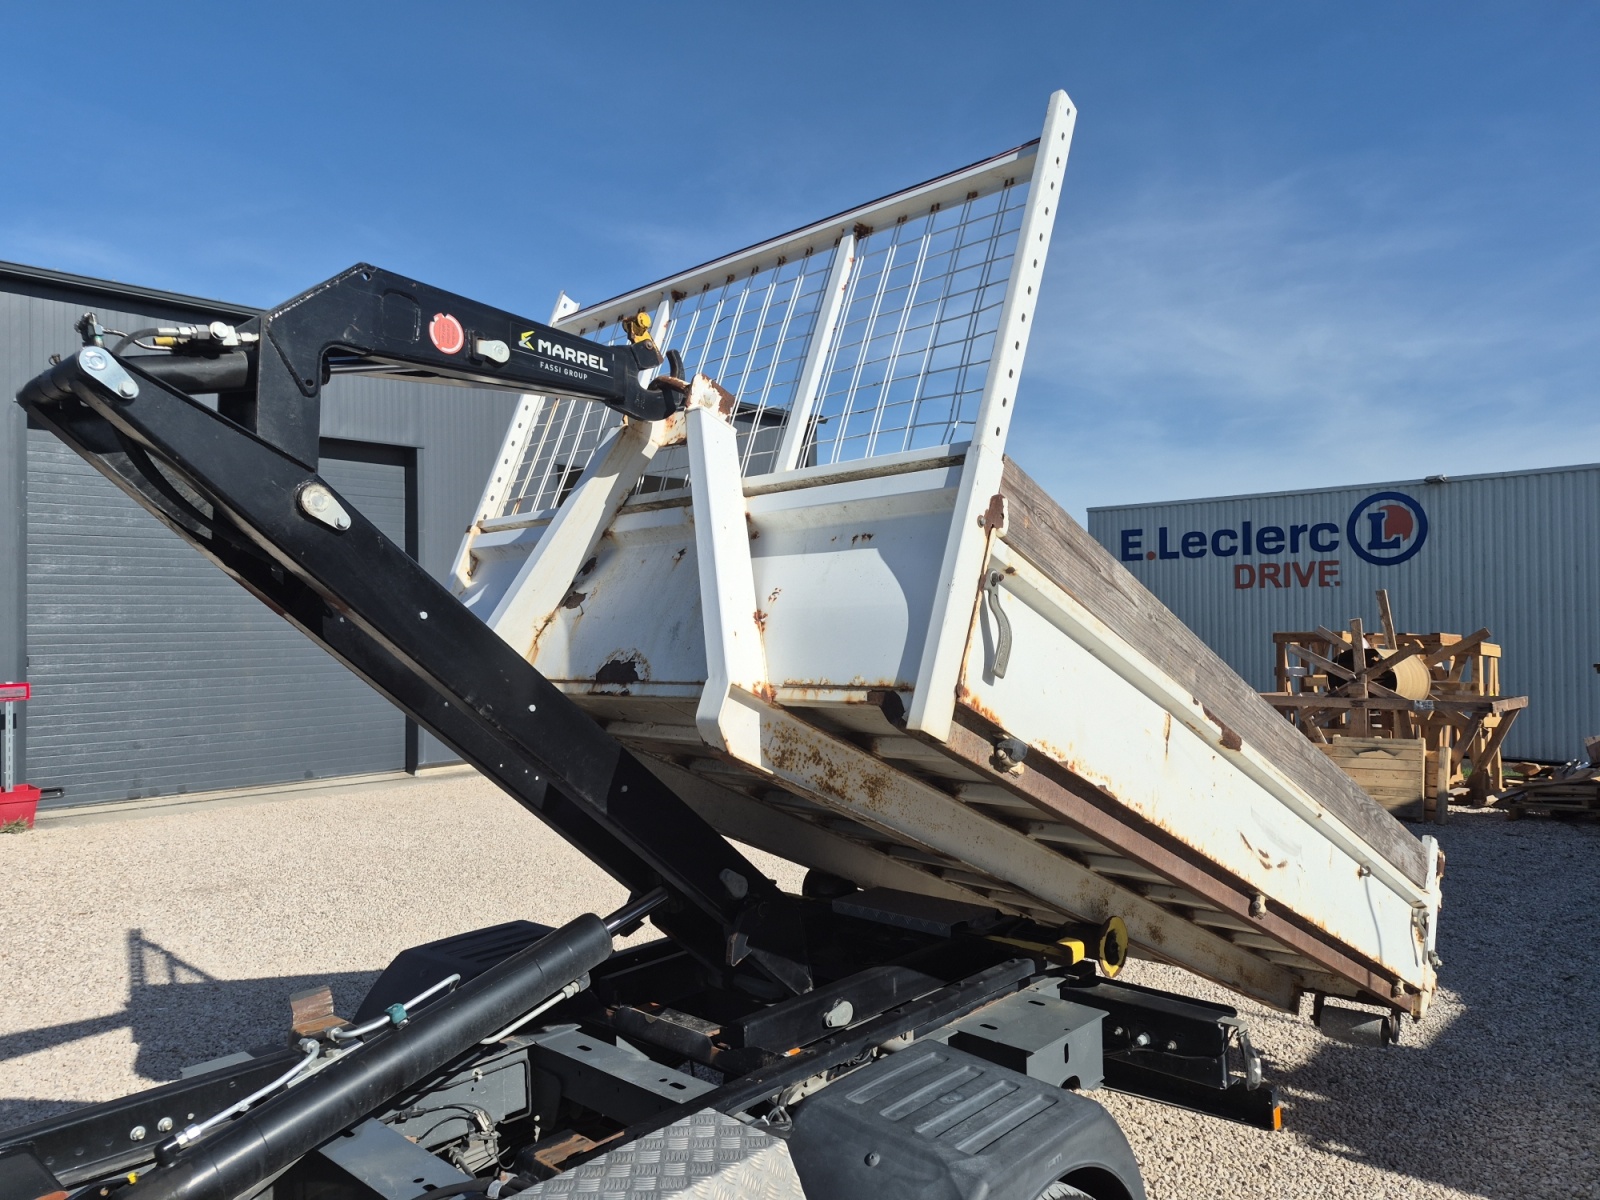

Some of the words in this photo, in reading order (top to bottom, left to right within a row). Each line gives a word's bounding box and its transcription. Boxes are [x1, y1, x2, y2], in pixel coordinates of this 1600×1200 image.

[537, 338, 609, 372] MARREL
[540, 361, 562, 374] FASSI
[563, 368, 588, 380] GROUP
[1120, 520, 1340, 562] E.Leclerc
[1233, 560, 1342, 590] DRIVE
